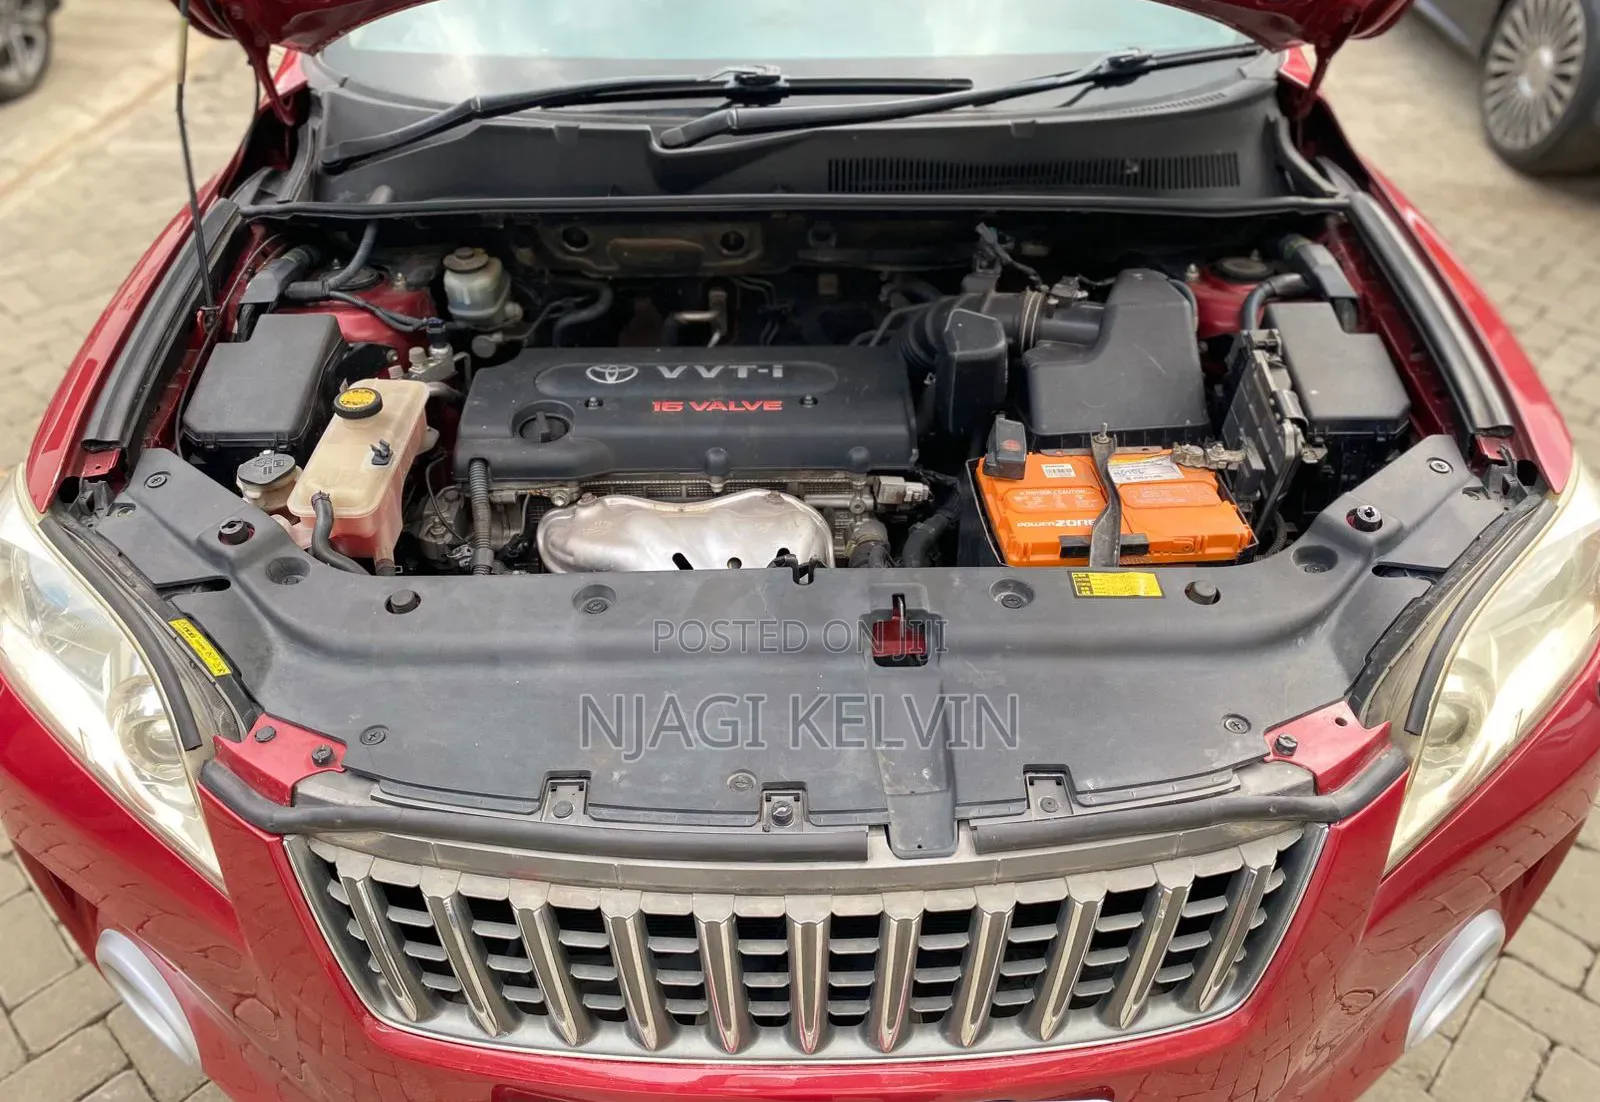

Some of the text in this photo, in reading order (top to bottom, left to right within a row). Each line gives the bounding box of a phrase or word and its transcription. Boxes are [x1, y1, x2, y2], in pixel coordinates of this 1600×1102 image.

[656, 364, 785, 379] VVT-i
[652, 399, 784, 412] 16 VALVE
